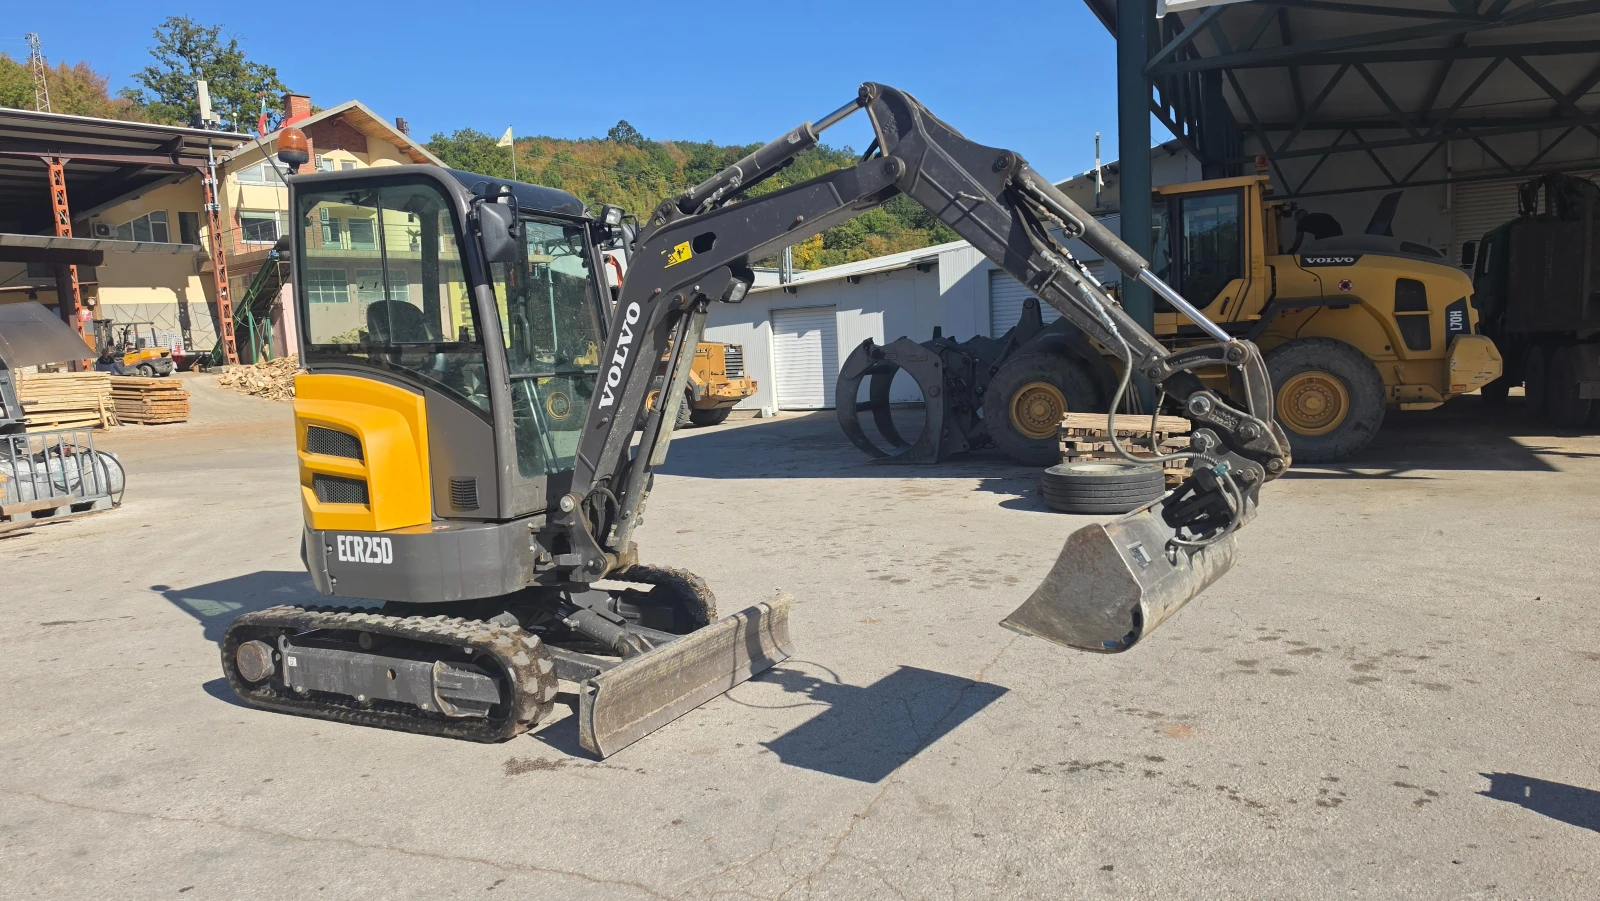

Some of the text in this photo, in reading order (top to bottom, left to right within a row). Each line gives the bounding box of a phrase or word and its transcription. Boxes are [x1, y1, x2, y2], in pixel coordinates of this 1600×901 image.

[1450, 310, 1463, 331] L70H
[598, 301, 641, 409] VOLVO
[337, 535, 394, 564] ECR25D
